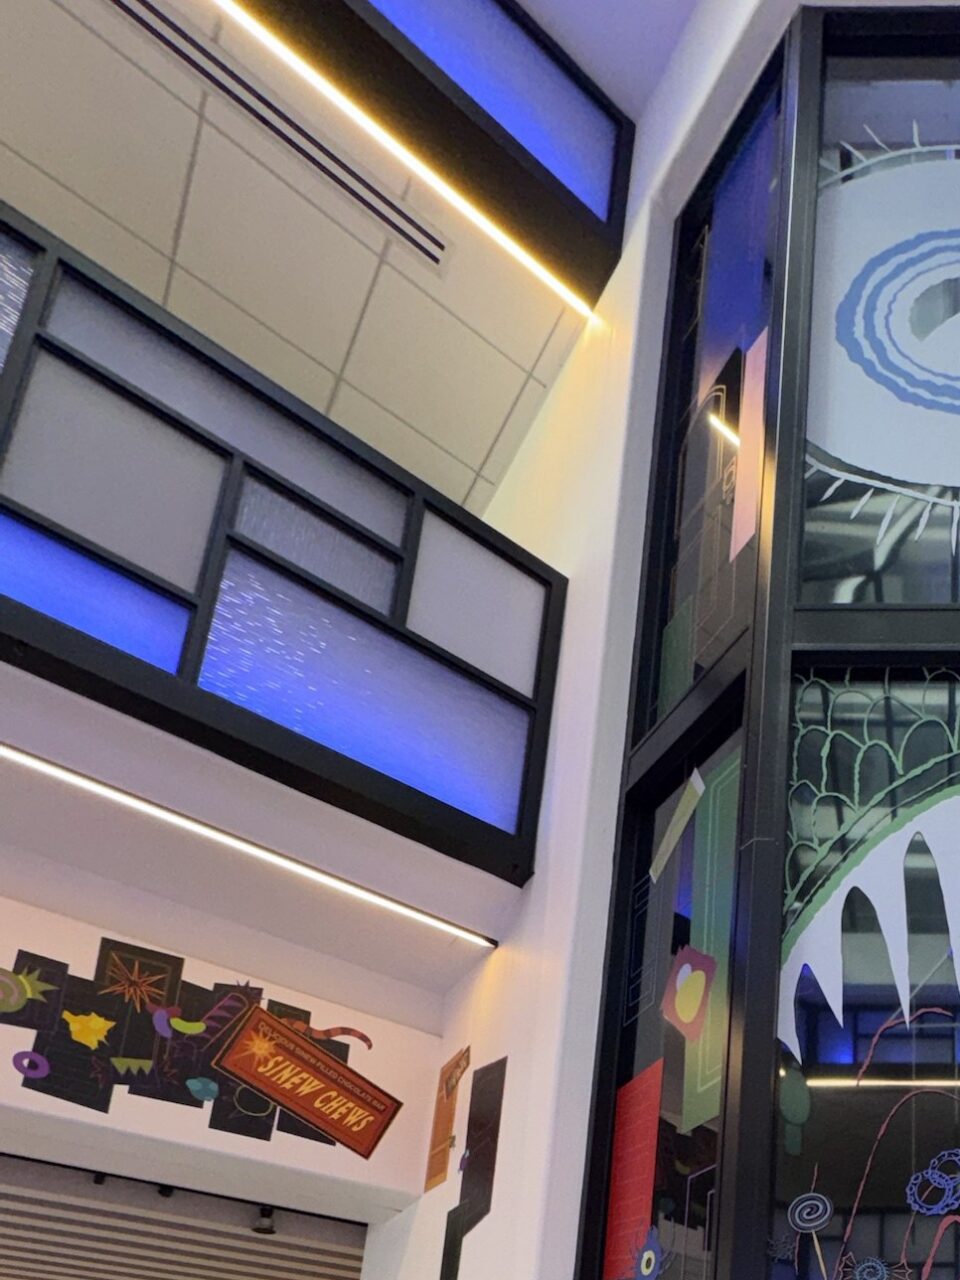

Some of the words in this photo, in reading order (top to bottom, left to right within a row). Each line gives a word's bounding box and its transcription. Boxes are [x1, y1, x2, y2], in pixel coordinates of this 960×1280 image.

[257, 1021, 296, 1050] DELICIOUS
[294, 1047, 317, 1065] SINEW
[315, 1060, 339, 1079] FILLED
[337, 1075, 373, 1101] CHOCOLATE
[372, 1099, 386, 1112] BAR
[257, 1056, 324, 1097] SINEW
[313, 1090, 375, 1132] CHEWS
